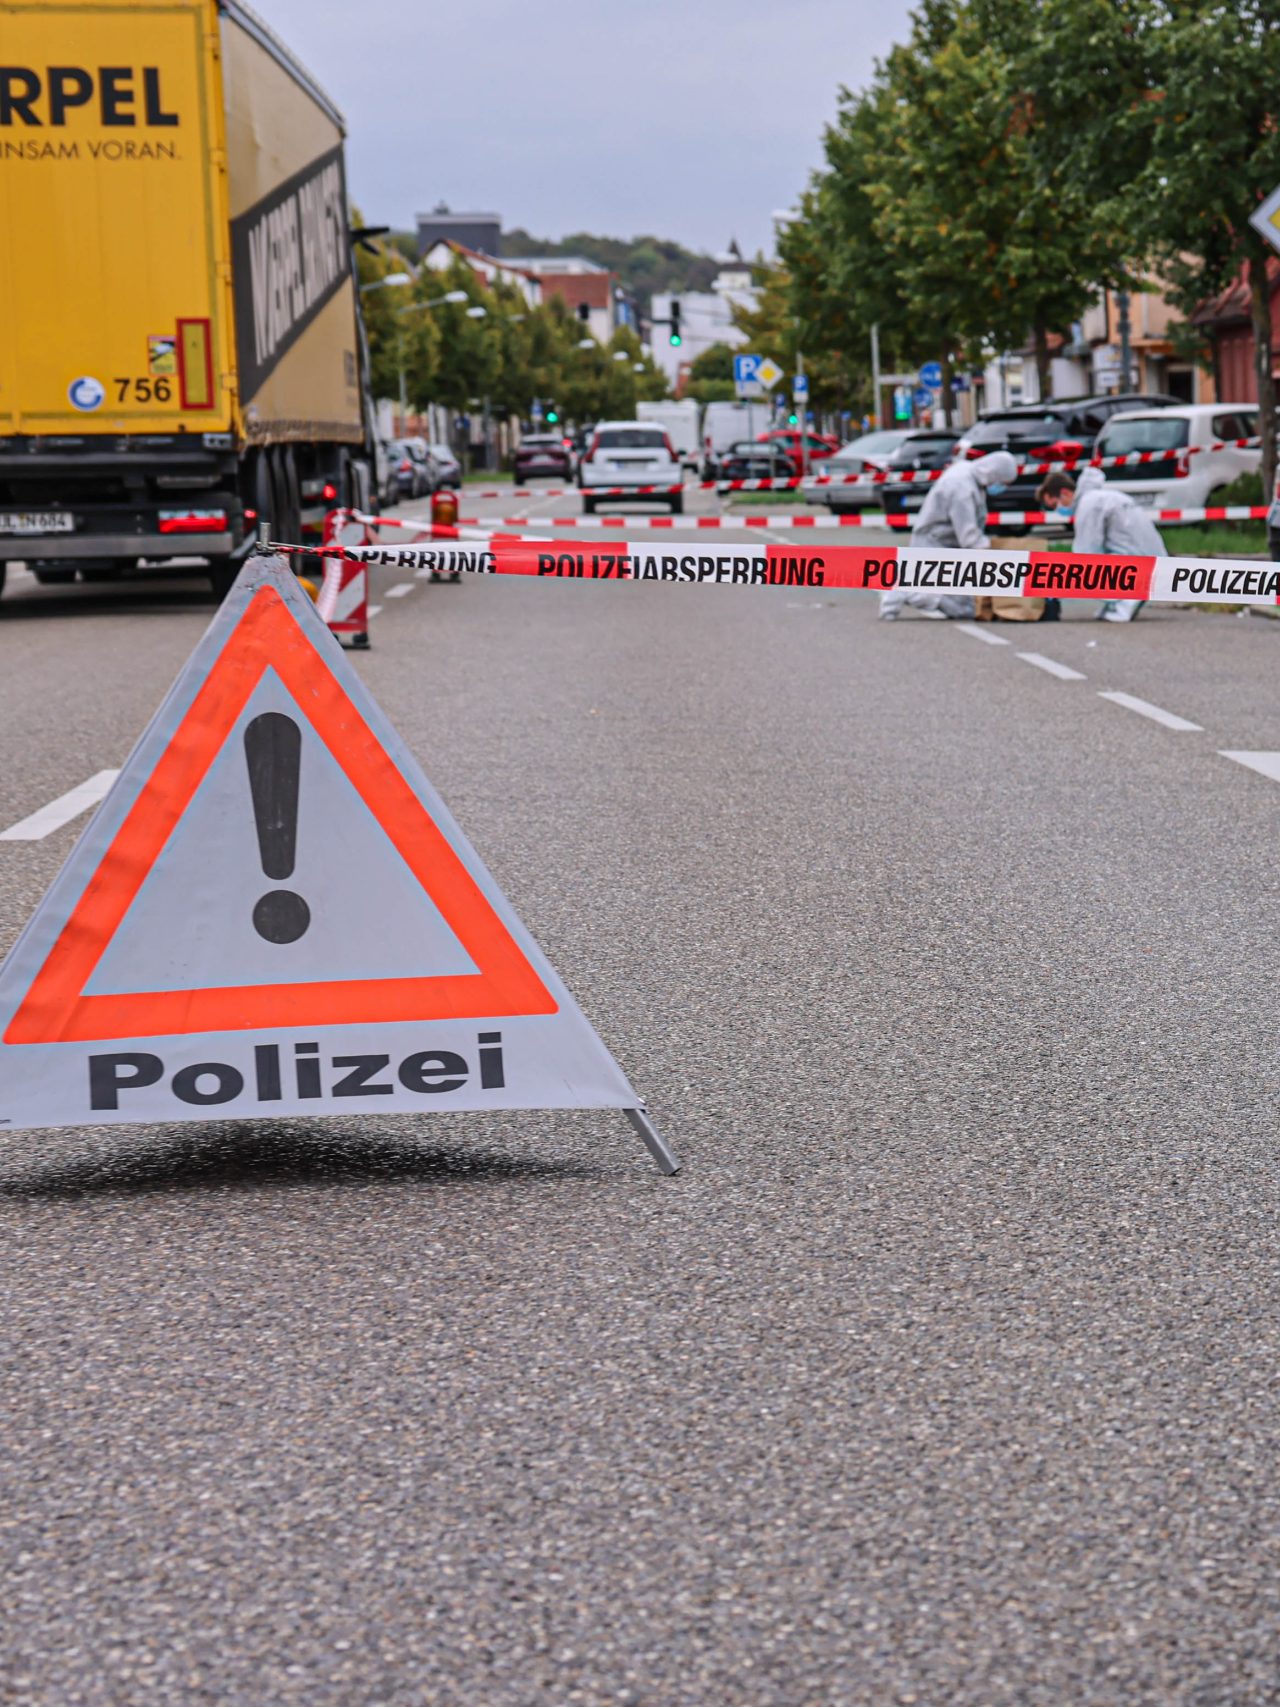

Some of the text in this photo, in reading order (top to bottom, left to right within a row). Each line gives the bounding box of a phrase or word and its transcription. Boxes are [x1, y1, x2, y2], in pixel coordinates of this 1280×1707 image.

[0, 66, 179, 127] RPEL
[113, 377, 171, 403] 756
[537, 553, 825, 586] POLIZEIABSPERRUNG
[862, 559, 1138, 591] POLIZEIABSPERRUNG
[88, 1031, 505, 1111] Polizei
